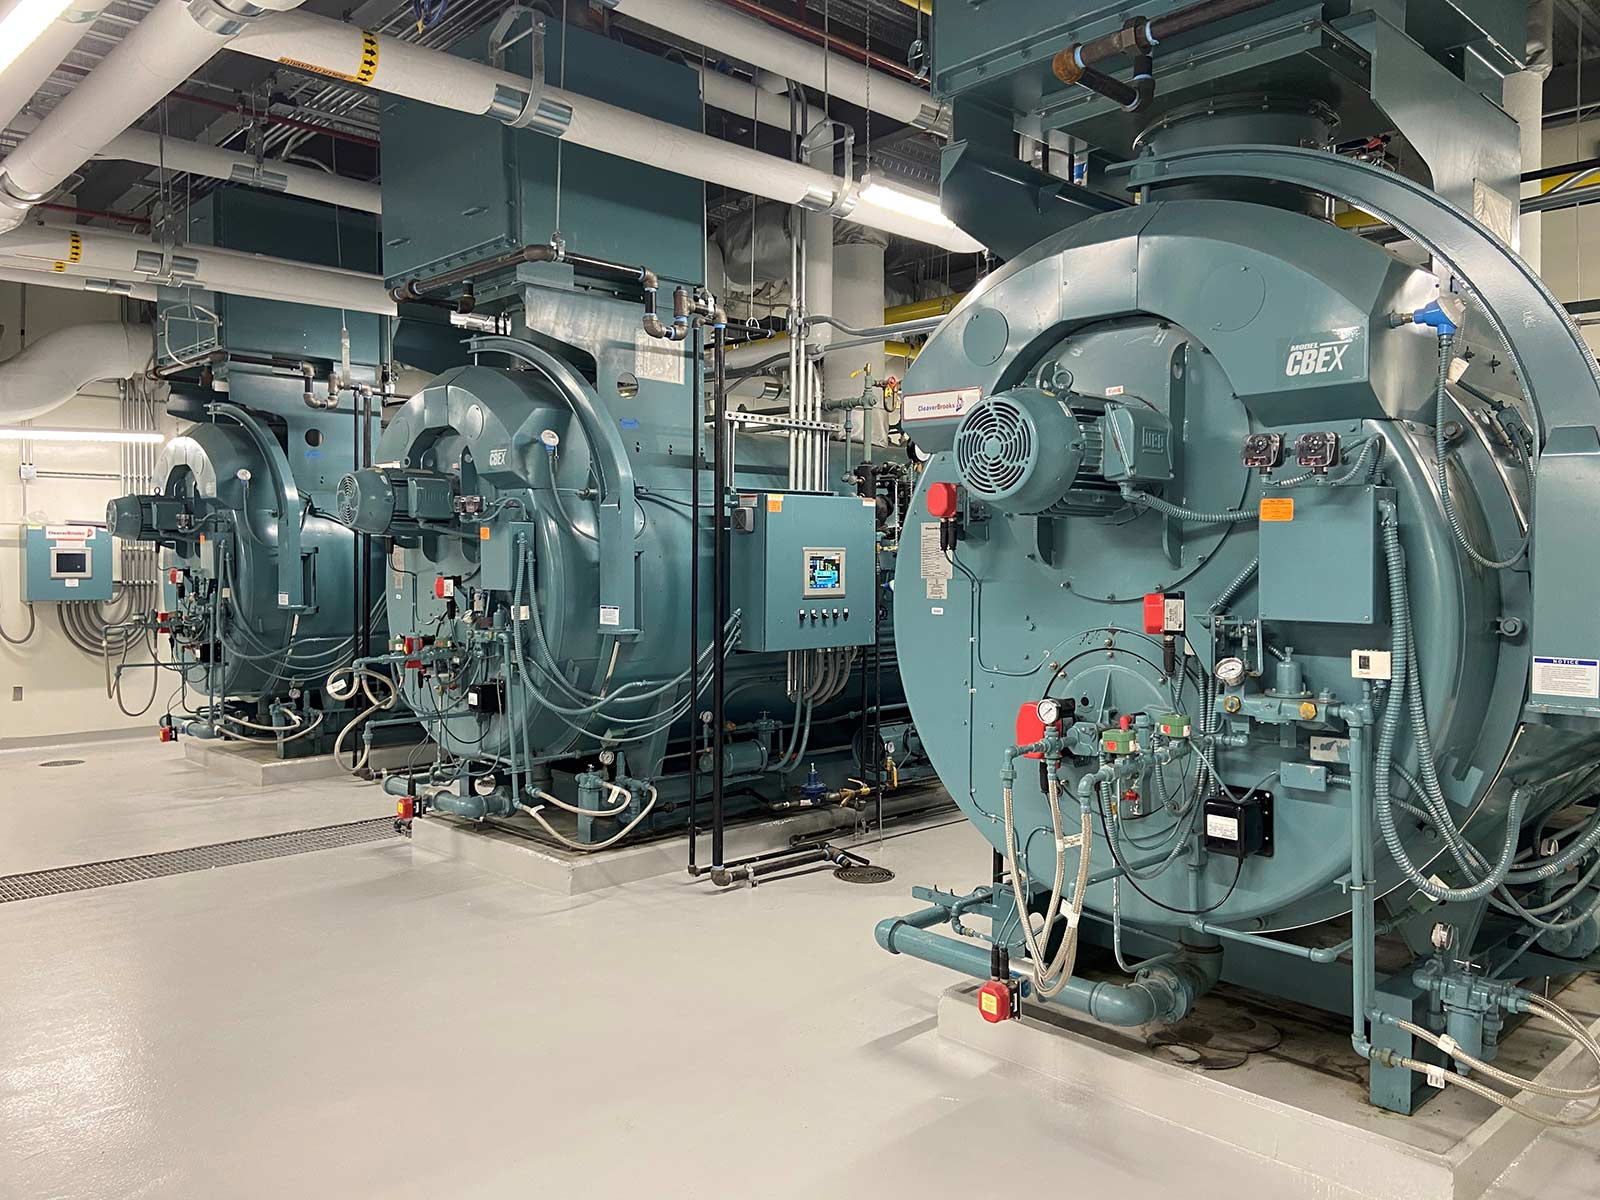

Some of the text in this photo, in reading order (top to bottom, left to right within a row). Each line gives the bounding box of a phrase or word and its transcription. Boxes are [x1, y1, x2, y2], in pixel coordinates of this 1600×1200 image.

[1290, 342, 1319, 352] MODEL
[1285, 344, 1349, 377] CBEX
[917, 402, 955, 412] CleaverBrooks
[1552, 658, 1579, 666] NOTICE
